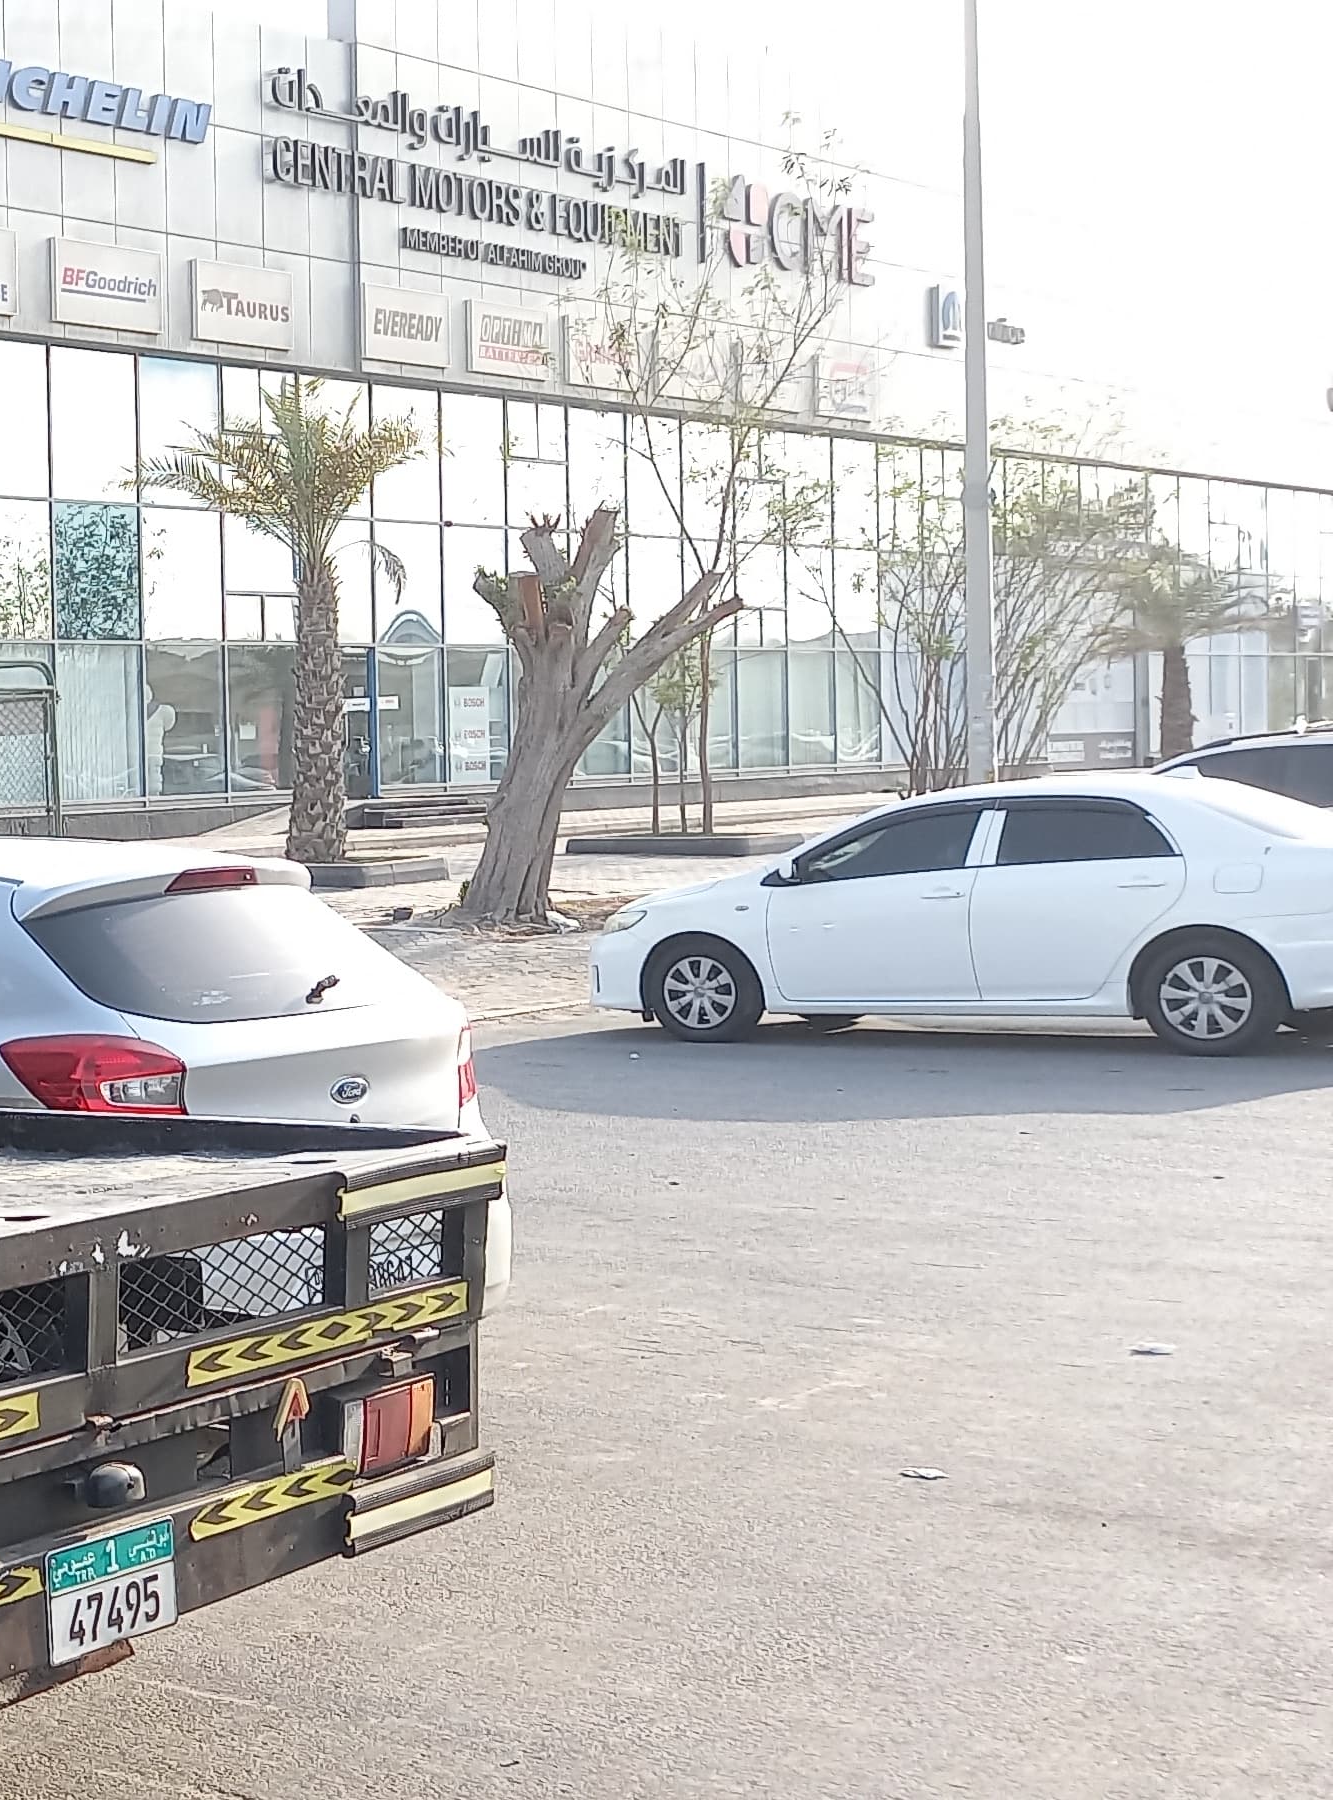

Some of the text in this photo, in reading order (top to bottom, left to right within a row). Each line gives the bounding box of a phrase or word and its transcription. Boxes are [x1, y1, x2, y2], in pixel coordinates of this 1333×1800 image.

[271, 135, 686, 258] CENTRAL MOTORS & EQUIPMENT
[399, 227, 465, 260] MEMBER
[484, 243, 543, 273] ALFAHIM
[543, 252, 587, 281] GROUP
[61, 266, 157, 298] BFGoodrich
[373, 307, 443, 343] EVEREADY
[480, 314, 545, 348] OPTIMA
[341, 1083, 363, 1098] Ford
[105, 1538, 120, 1573] 1
[68, 1573, 161, 1647] 47495
